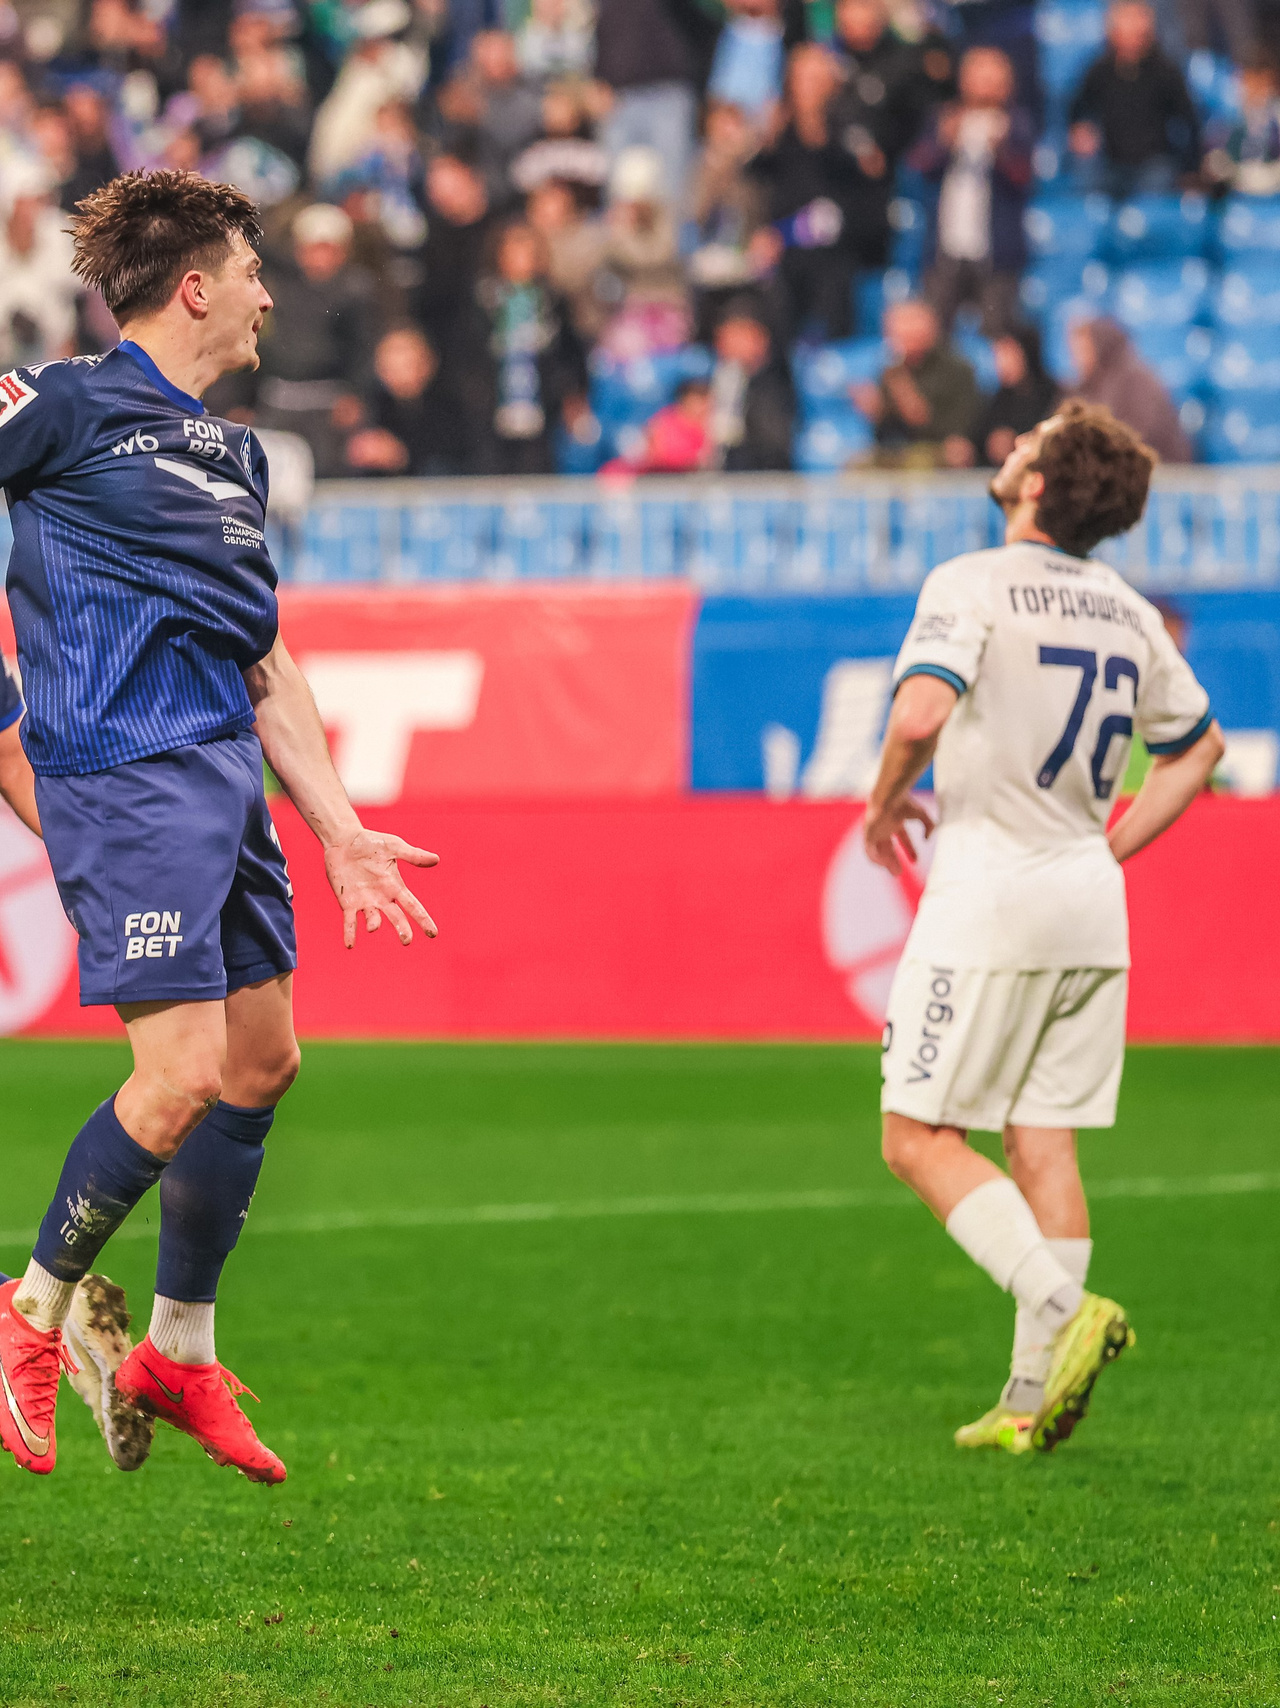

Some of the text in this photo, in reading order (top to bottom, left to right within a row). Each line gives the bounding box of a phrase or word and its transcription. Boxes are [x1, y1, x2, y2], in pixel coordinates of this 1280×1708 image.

[183, 419, 224, 443] FON
[187, 439, 228, 461] BET
[223, 535, 261, 549] ОБЛАСТИ
[1038, 646, 1140, 800] 72
[124, 911, 182, 937] FON
[125, 935, 183, 960] BET
[906, 966, 955, 1084] Vorgol
